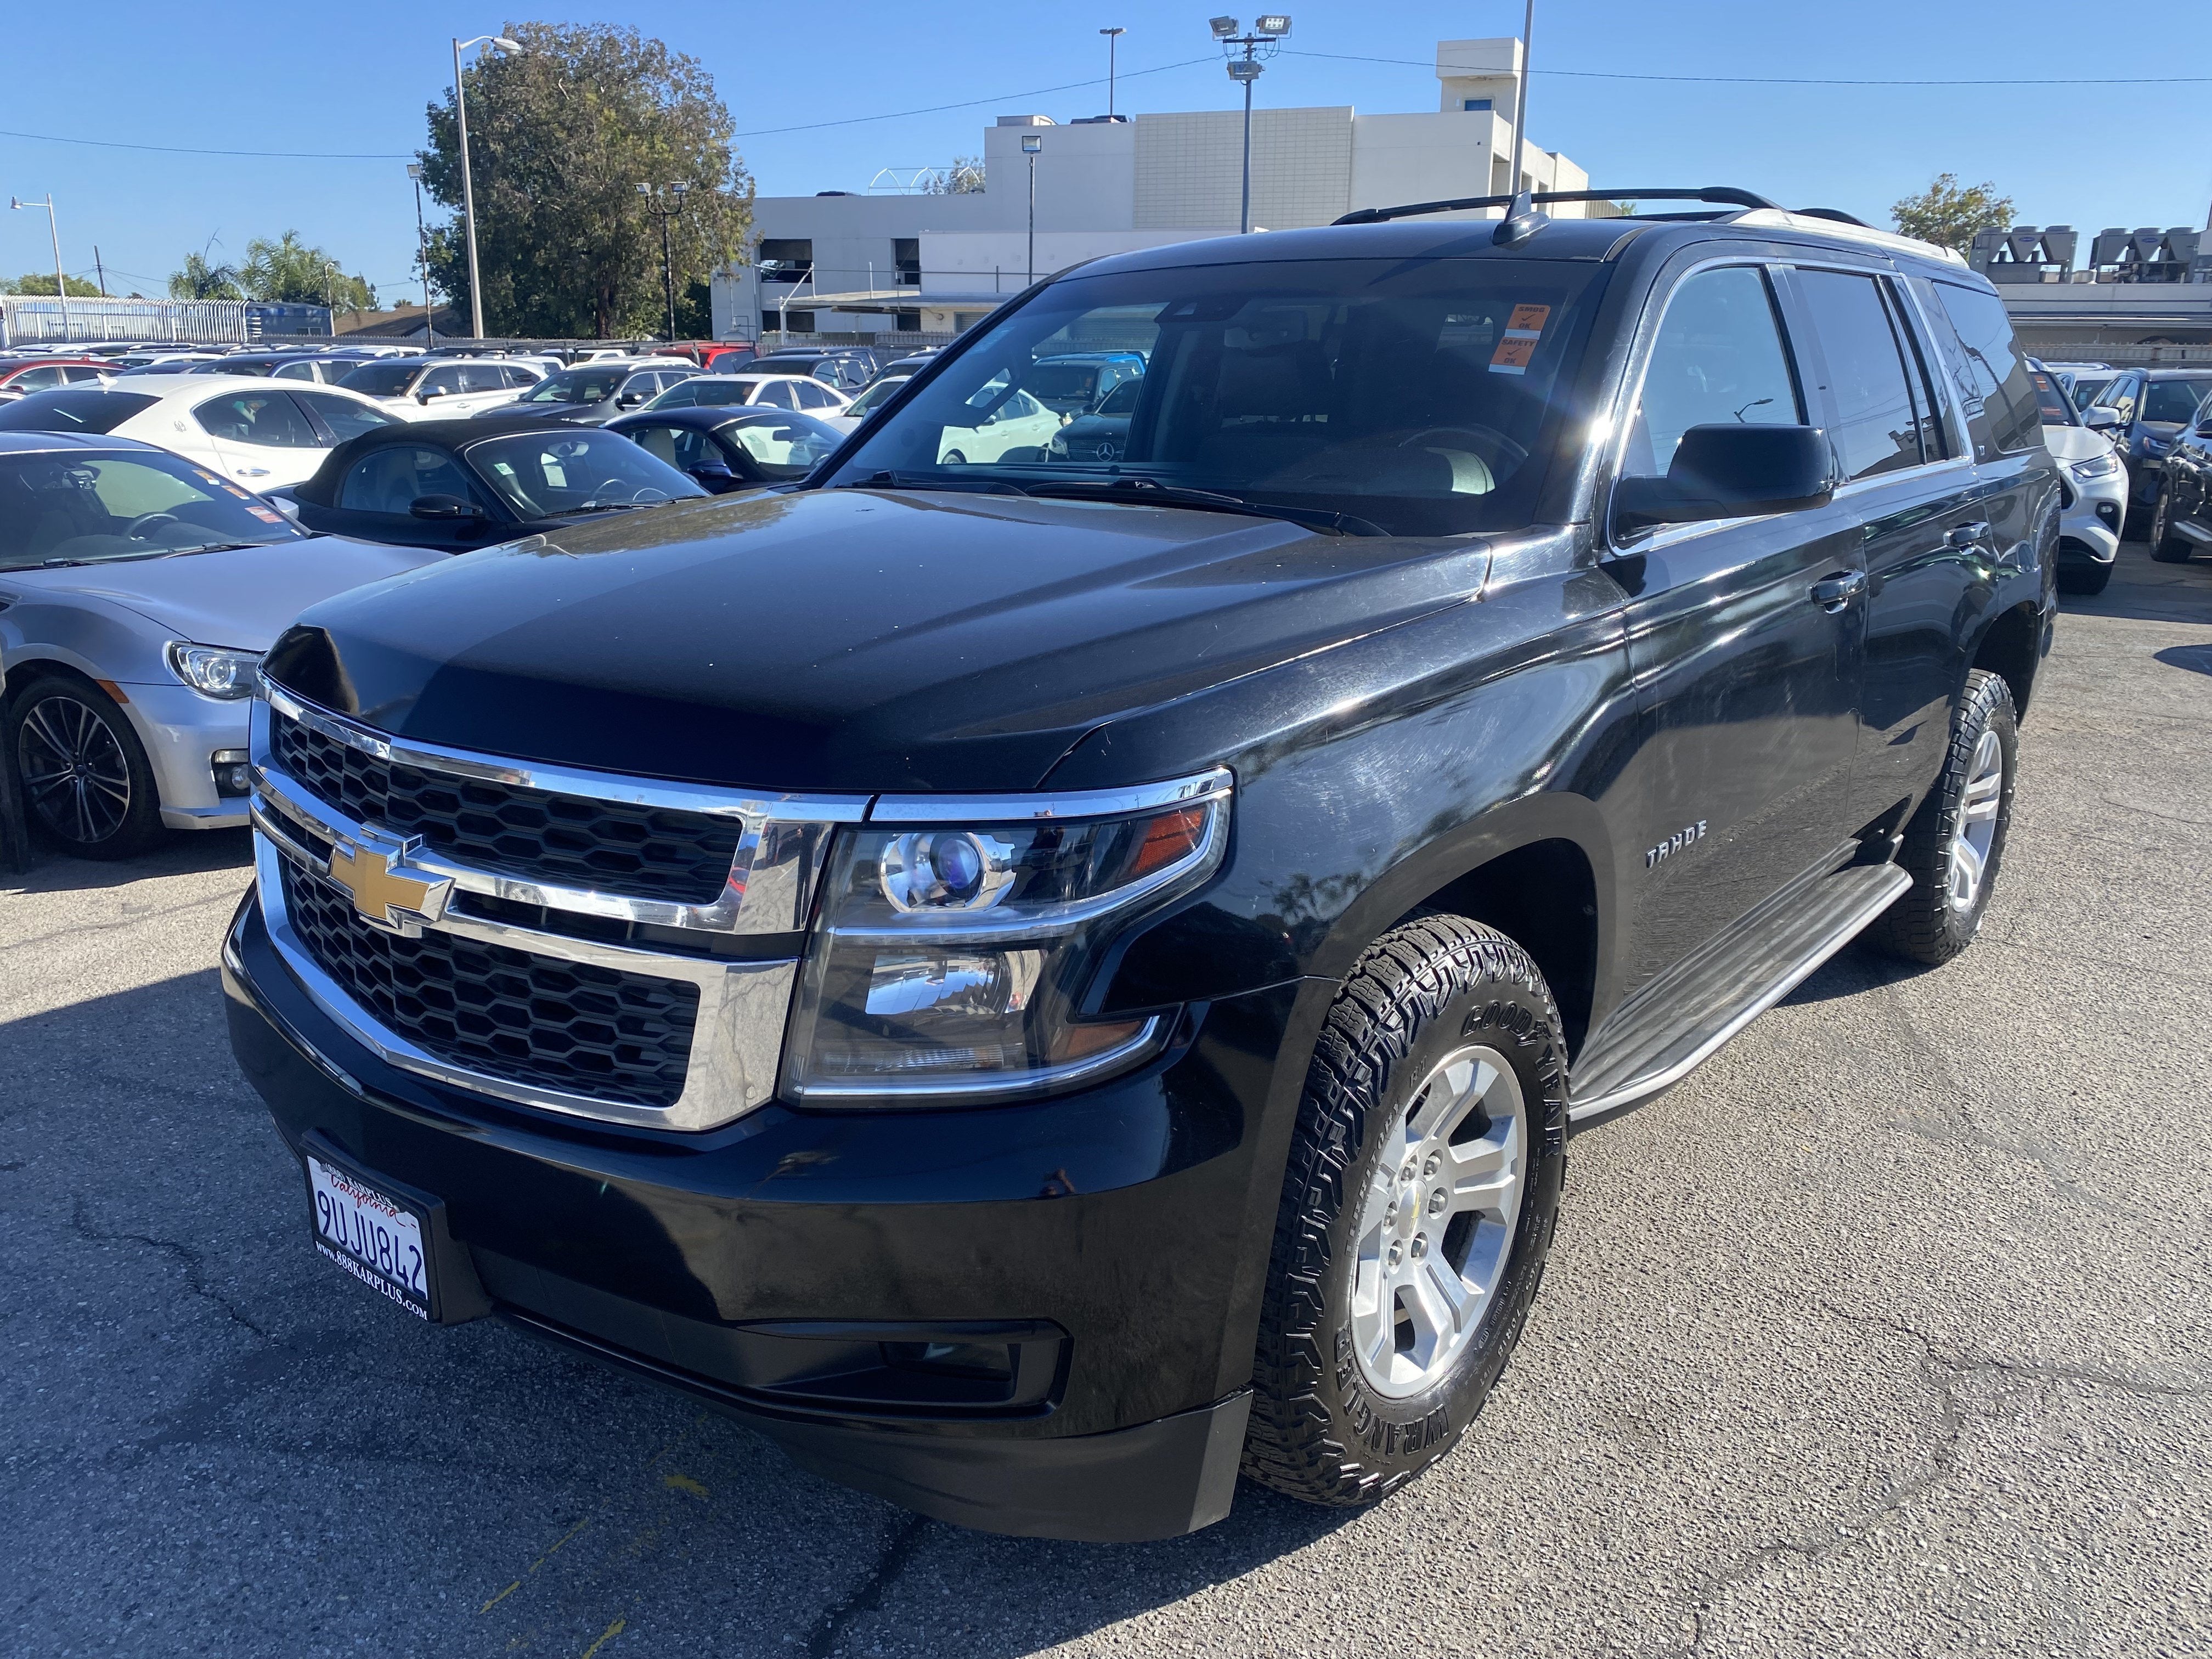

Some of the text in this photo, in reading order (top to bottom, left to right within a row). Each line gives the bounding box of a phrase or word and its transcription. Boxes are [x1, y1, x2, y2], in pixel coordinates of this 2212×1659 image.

[1502, 338, 1535, 347] SAFETY
[1645, 820, 1707, 868] TAHOE
[317, 1190, 427, 1300] 9UJU842
